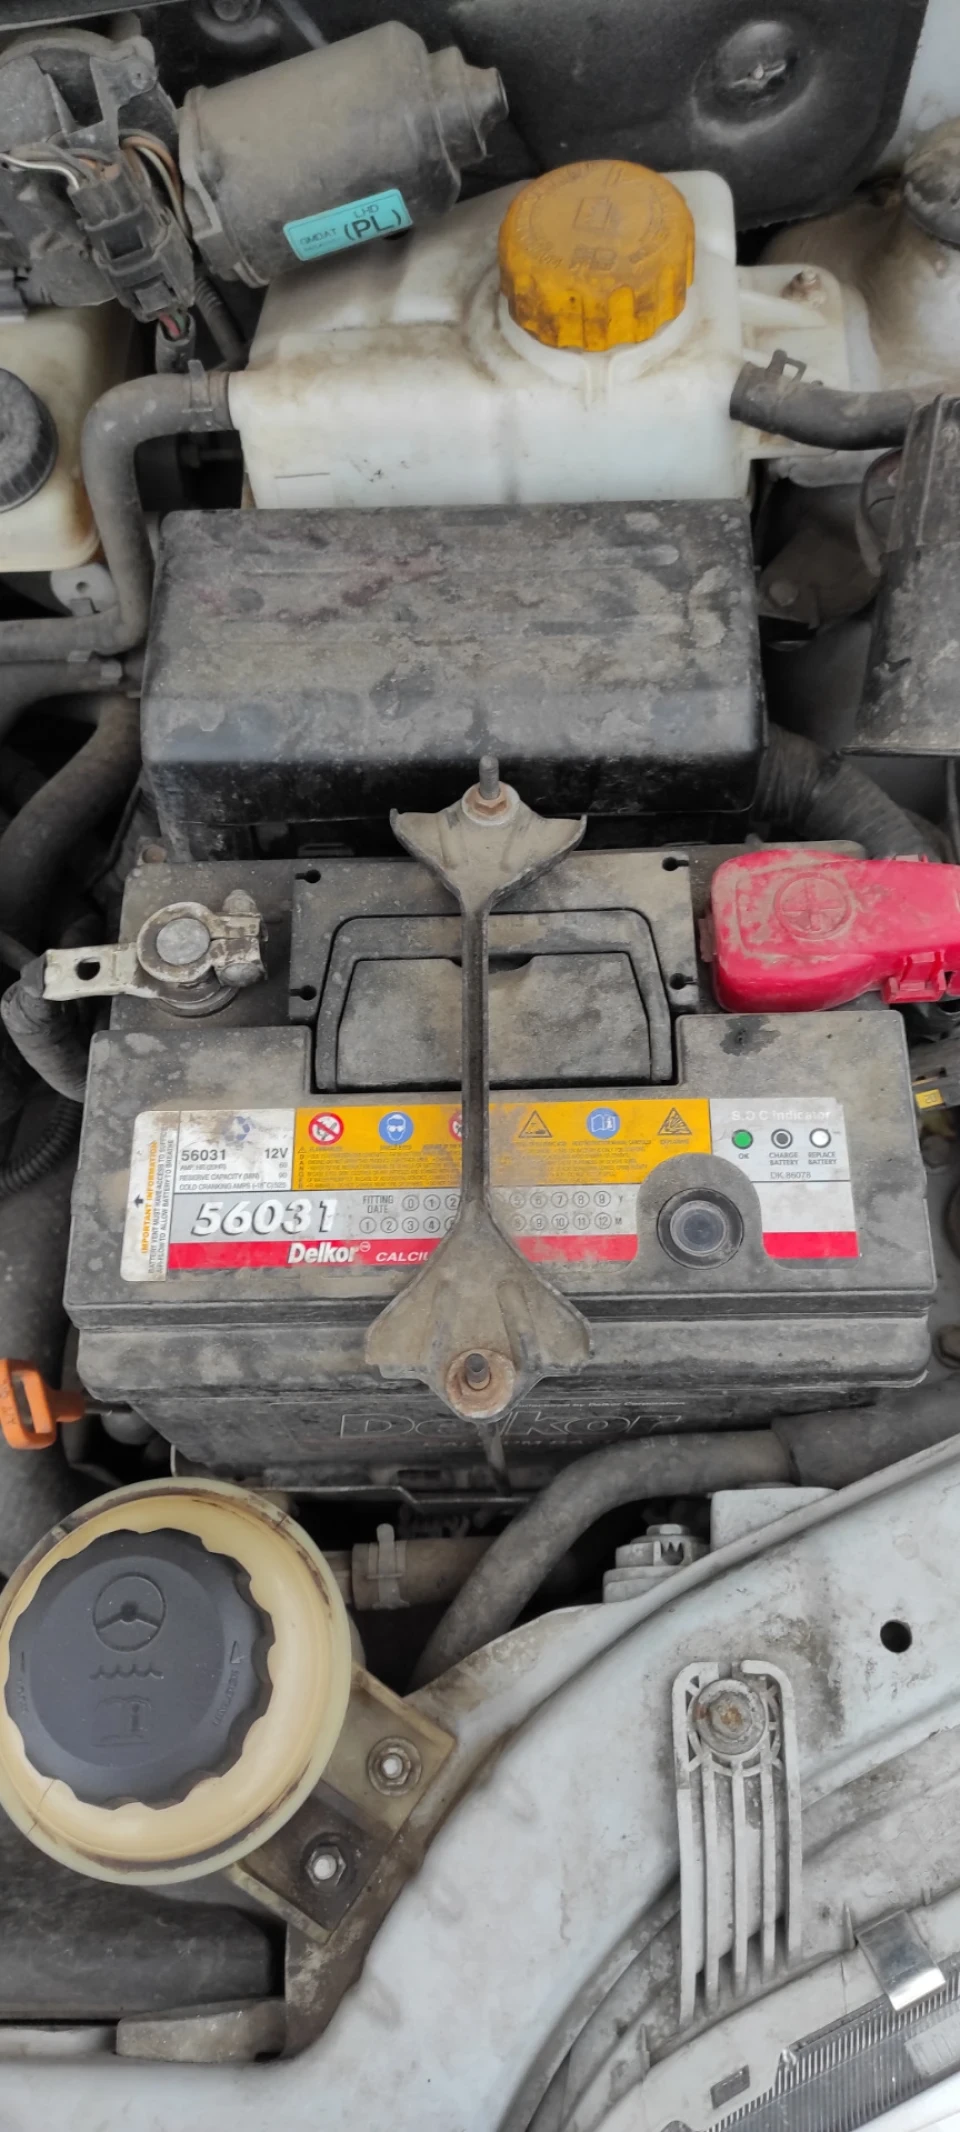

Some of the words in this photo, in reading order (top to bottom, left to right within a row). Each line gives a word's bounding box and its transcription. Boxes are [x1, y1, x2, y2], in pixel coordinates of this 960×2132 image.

[344, 209, 401, 241] (PL)
[165, 1139, 173, 1168] BREATHE
[181, 1149, 226, 1161] 56031
[265, 1148, 288, 1159] 12V
[141, 1203, 152, 1254] IMPORTANT
[147, 1140, 158, 1202] INFORMATION
[162, 1180, 170, 1208] BATTERY
[362, 1195, 394, 1204] FITTING
[152, 1208, 161, 1226] MUST
[160, 1209, 169, 1231] ALLOW
[190, 1198, 338, 1237] 56031
[367, 1204, 389, 1214] DATE
[615, 1217, 622, 1225] M
[150, 1226, 159, 1243] VENT
[287, 1242, 360, 1264] Delkor
[340, 1411, 681, 1439] Dekor
